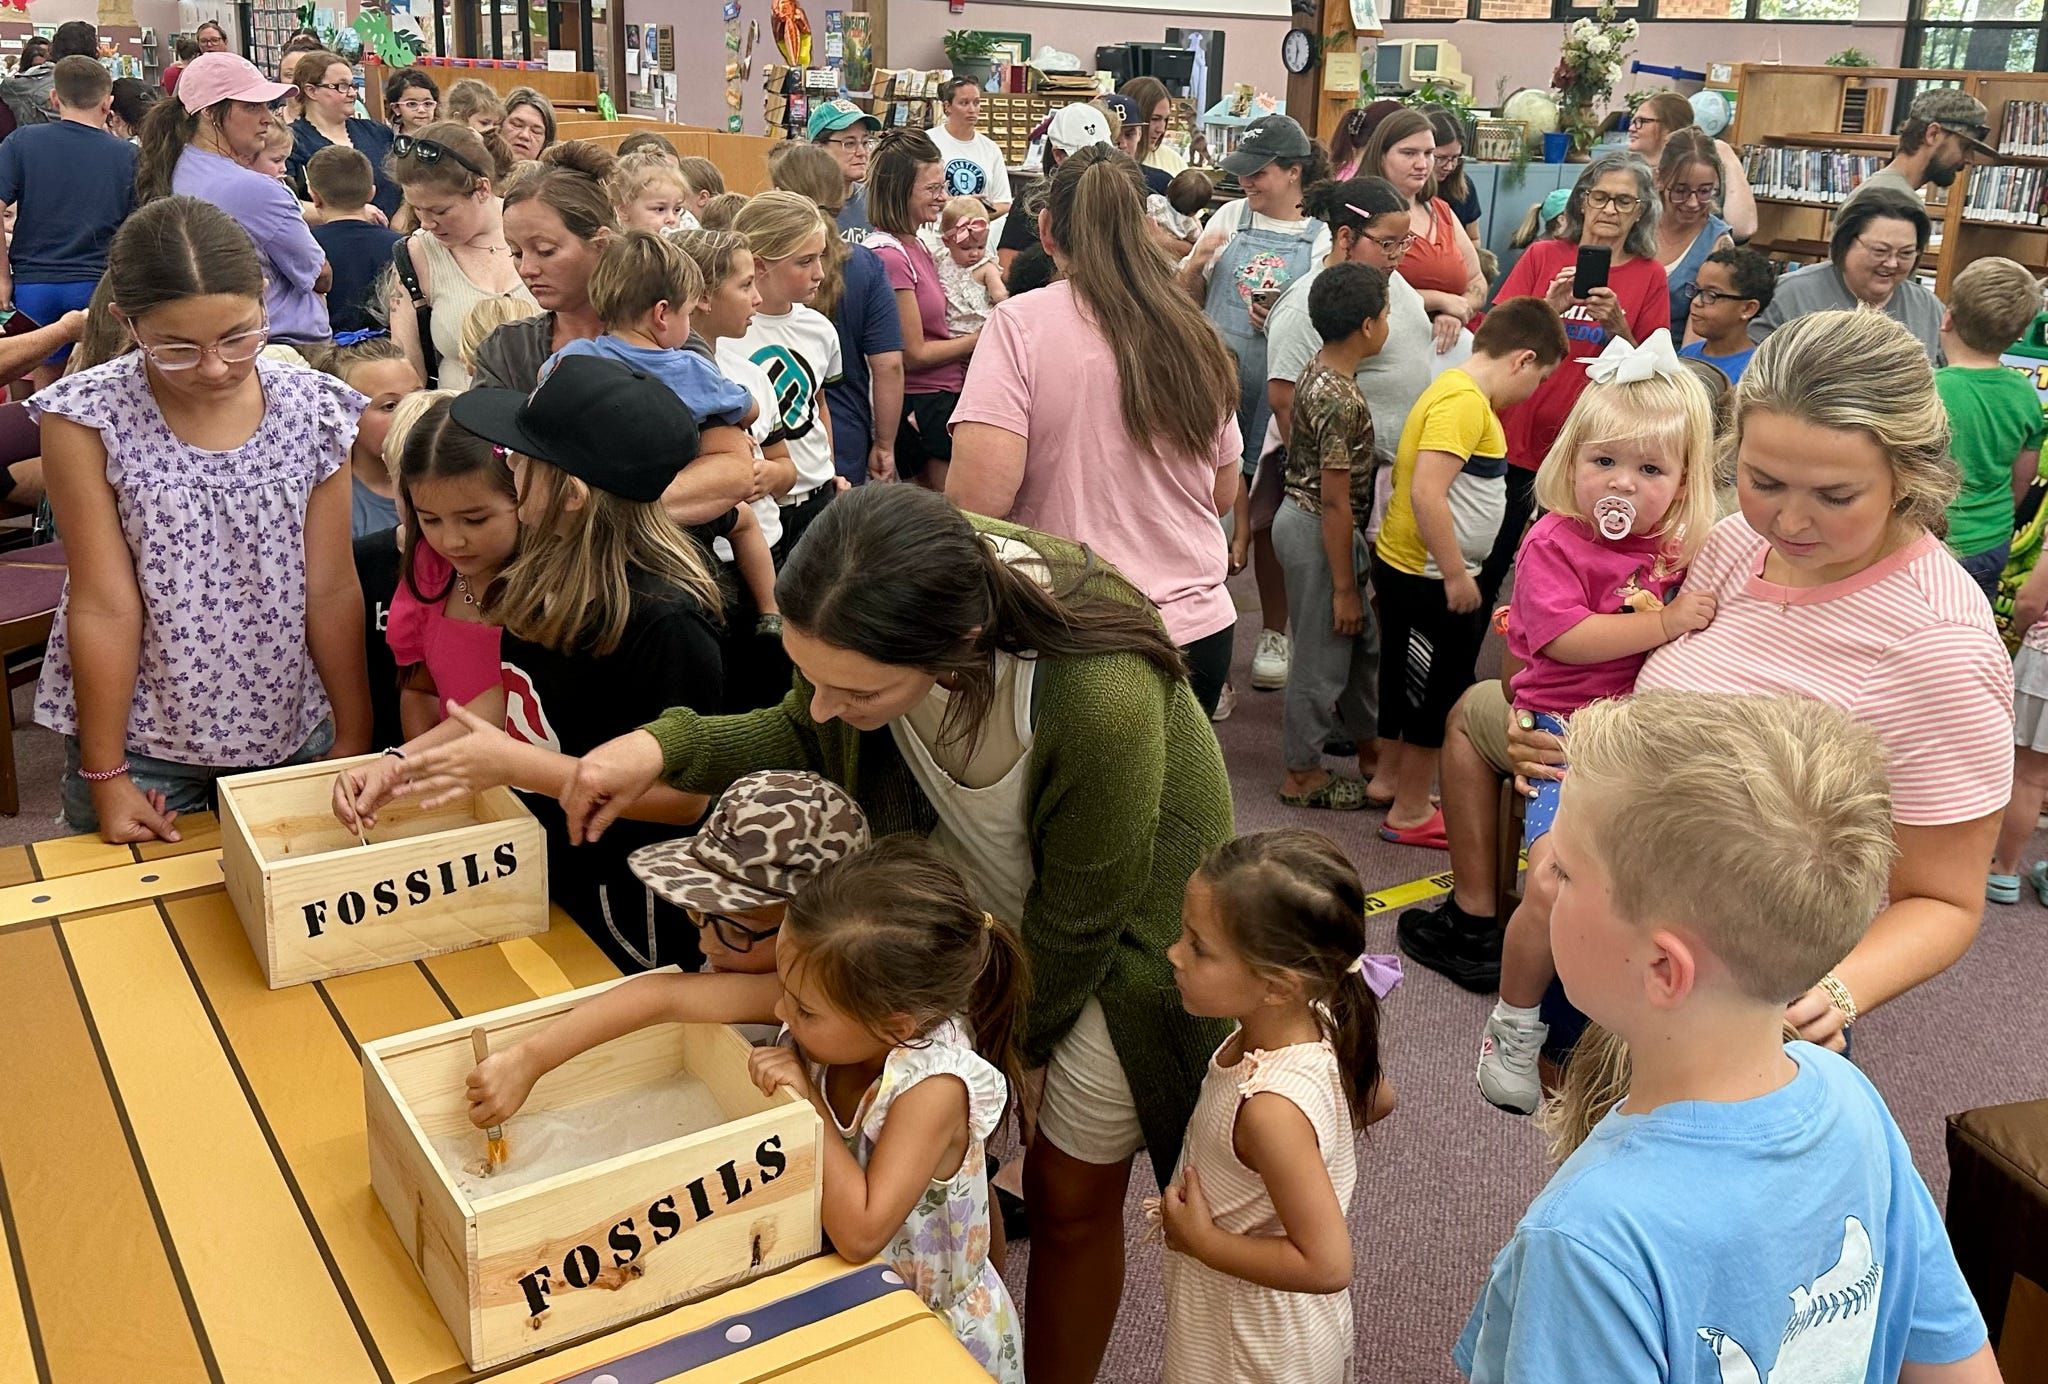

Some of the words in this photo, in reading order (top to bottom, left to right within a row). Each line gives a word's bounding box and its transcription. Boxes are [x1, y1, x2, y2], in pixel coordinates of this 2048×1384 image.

[1114, 104, 1127, 121] B
[302, 842, 519, 938] FOSSILS
[518, 1134, 787, 1317] FOSSILS
